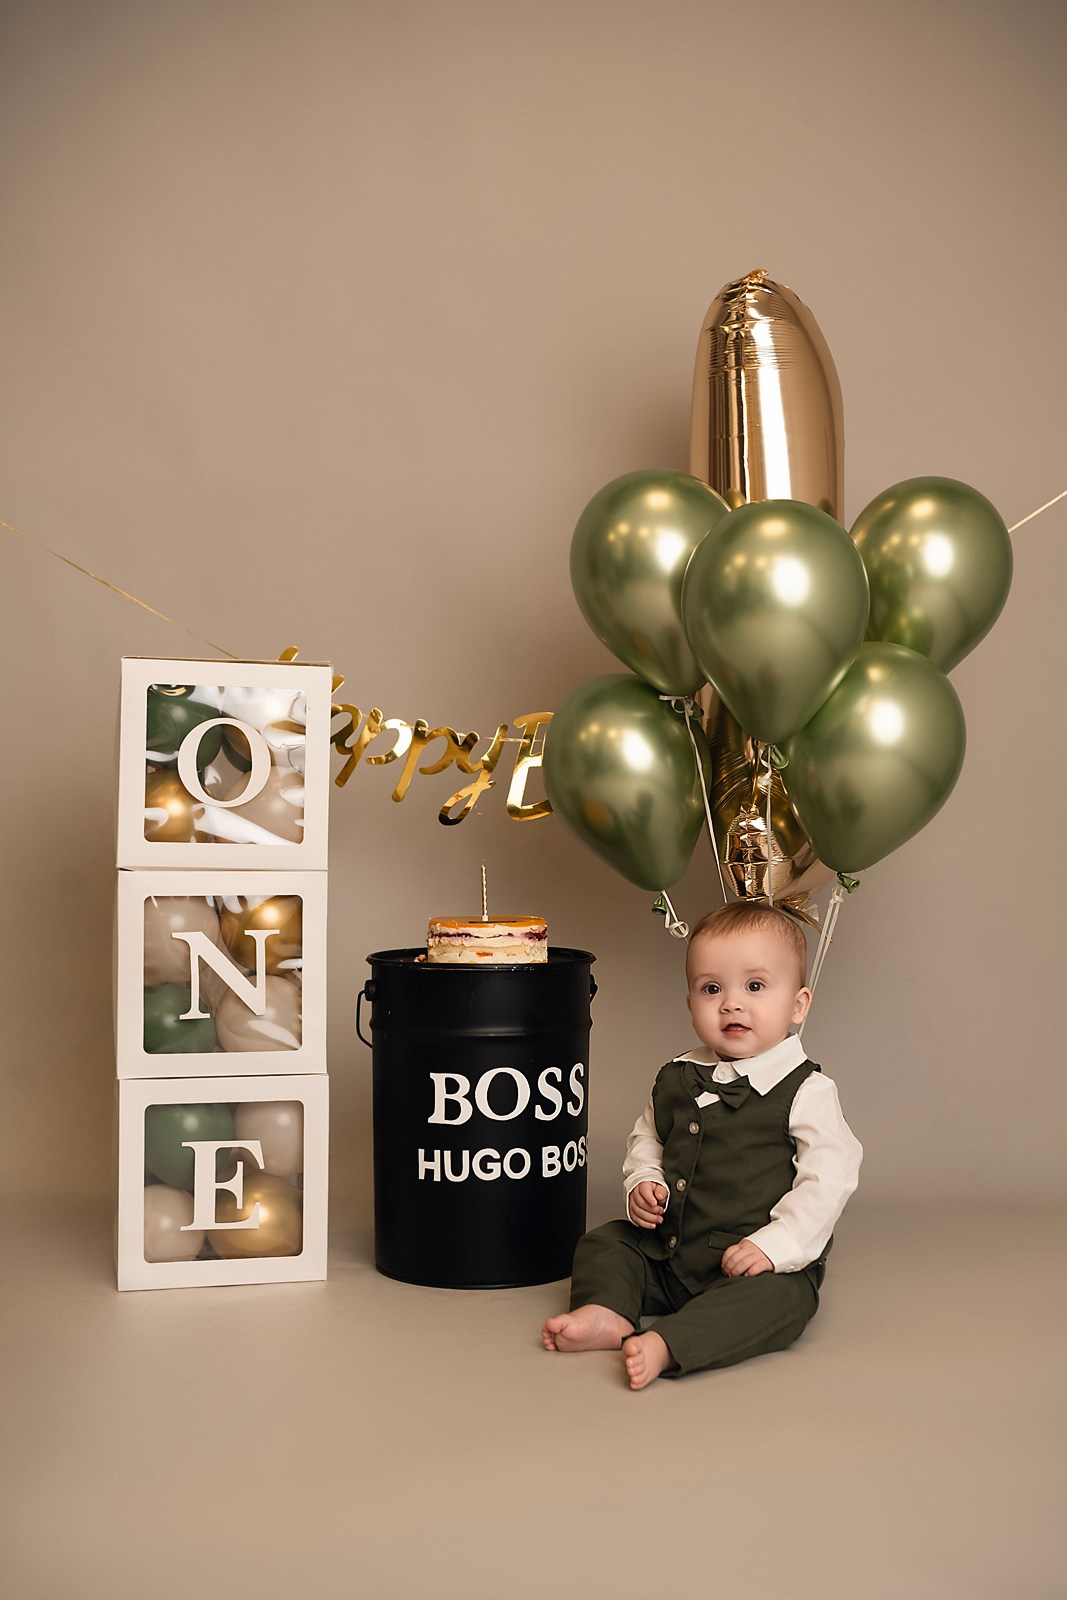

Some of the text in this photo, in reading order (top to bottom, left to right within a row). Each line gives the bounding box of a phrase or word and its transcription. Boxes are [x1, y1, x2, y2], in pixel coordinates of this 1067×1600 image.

[331, 675, 508, 826] appy
[428, 1063, 585, 1125] BOSS
[418, 1134, 589, 1182] HUGO BOS
